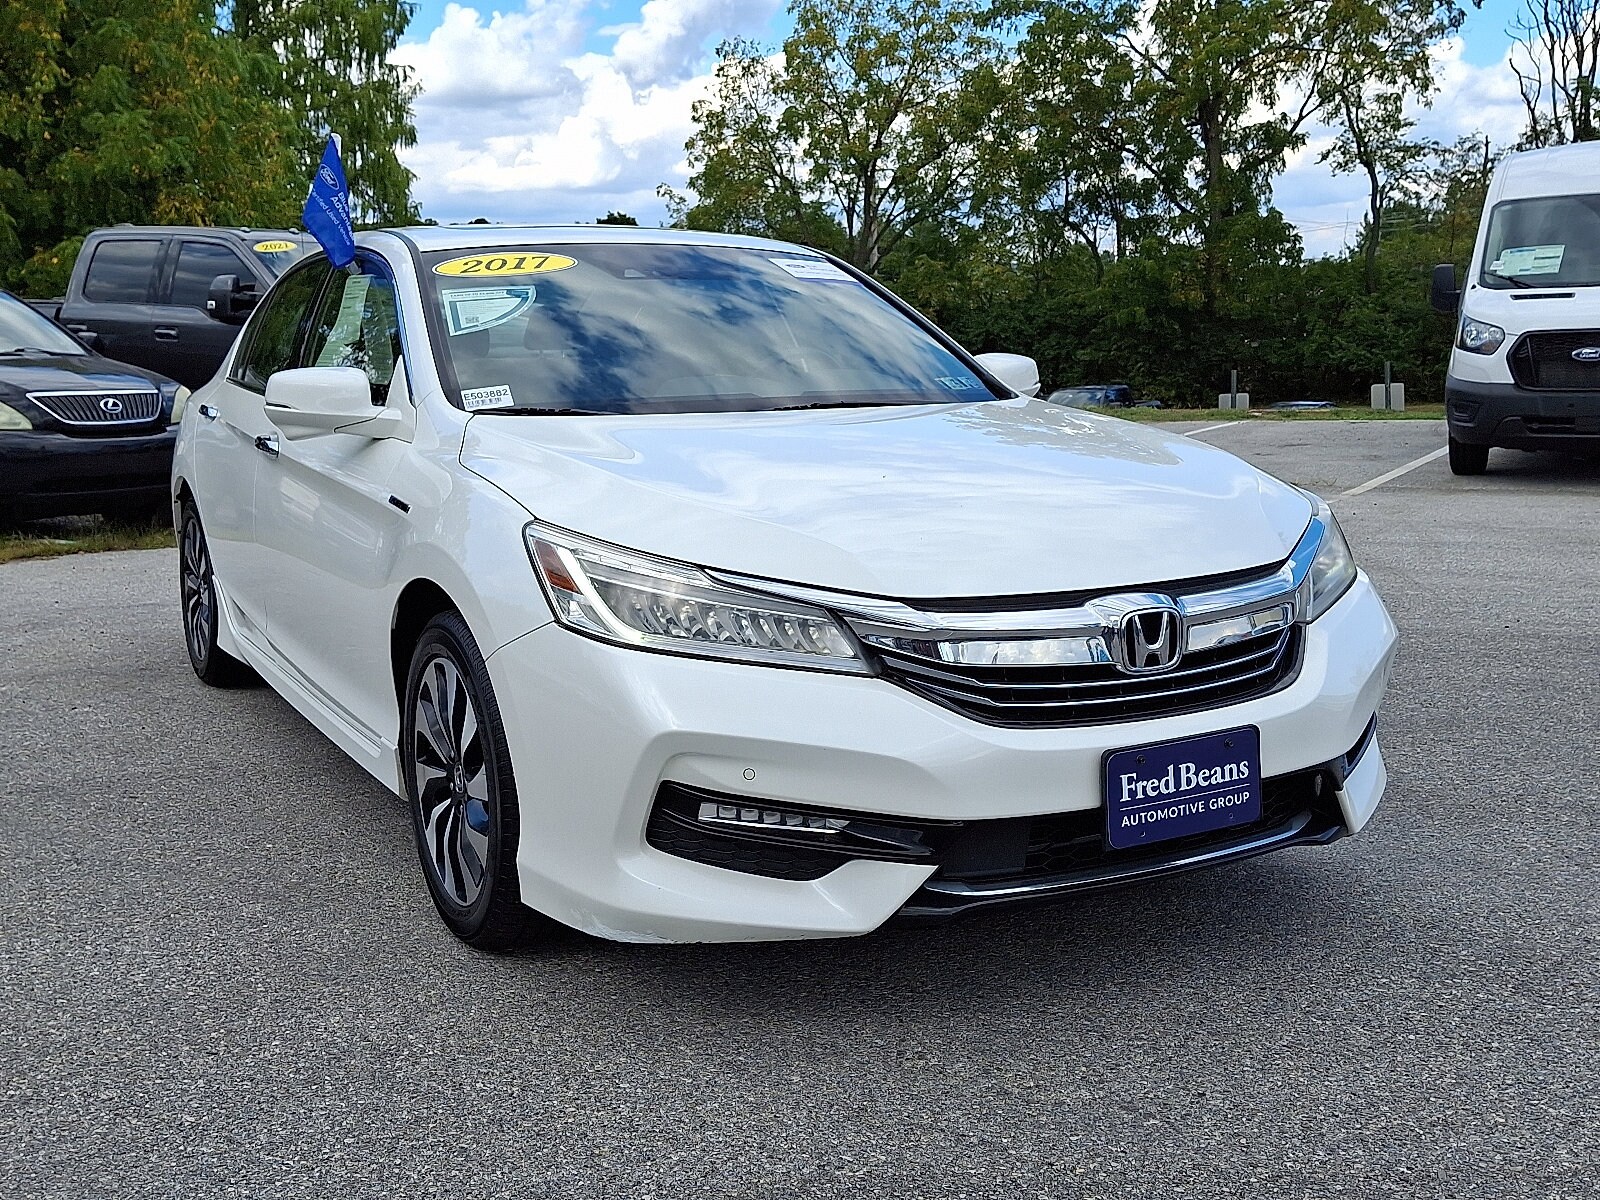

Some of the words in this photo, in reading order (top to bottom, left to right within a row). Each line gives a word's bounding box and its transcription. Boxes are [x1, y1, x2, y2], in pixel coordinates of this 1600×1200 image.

[320, 166, 337, 186] Ford
[337, 191, 350, 212] Blue
[325, 208, 341, 226] Used
[262, 242, 289, 251] 2021
[459, 256, 551, 274] 2017
[463, 388, 510, 401] E503882
[1119, 763, 1176, 803] Fred
[1178, 760, 1250, 792] Beans
[1121, 800, 1206, 828] AUTOMOTIVE
[1209, 791, 1250, 811] GROUP
